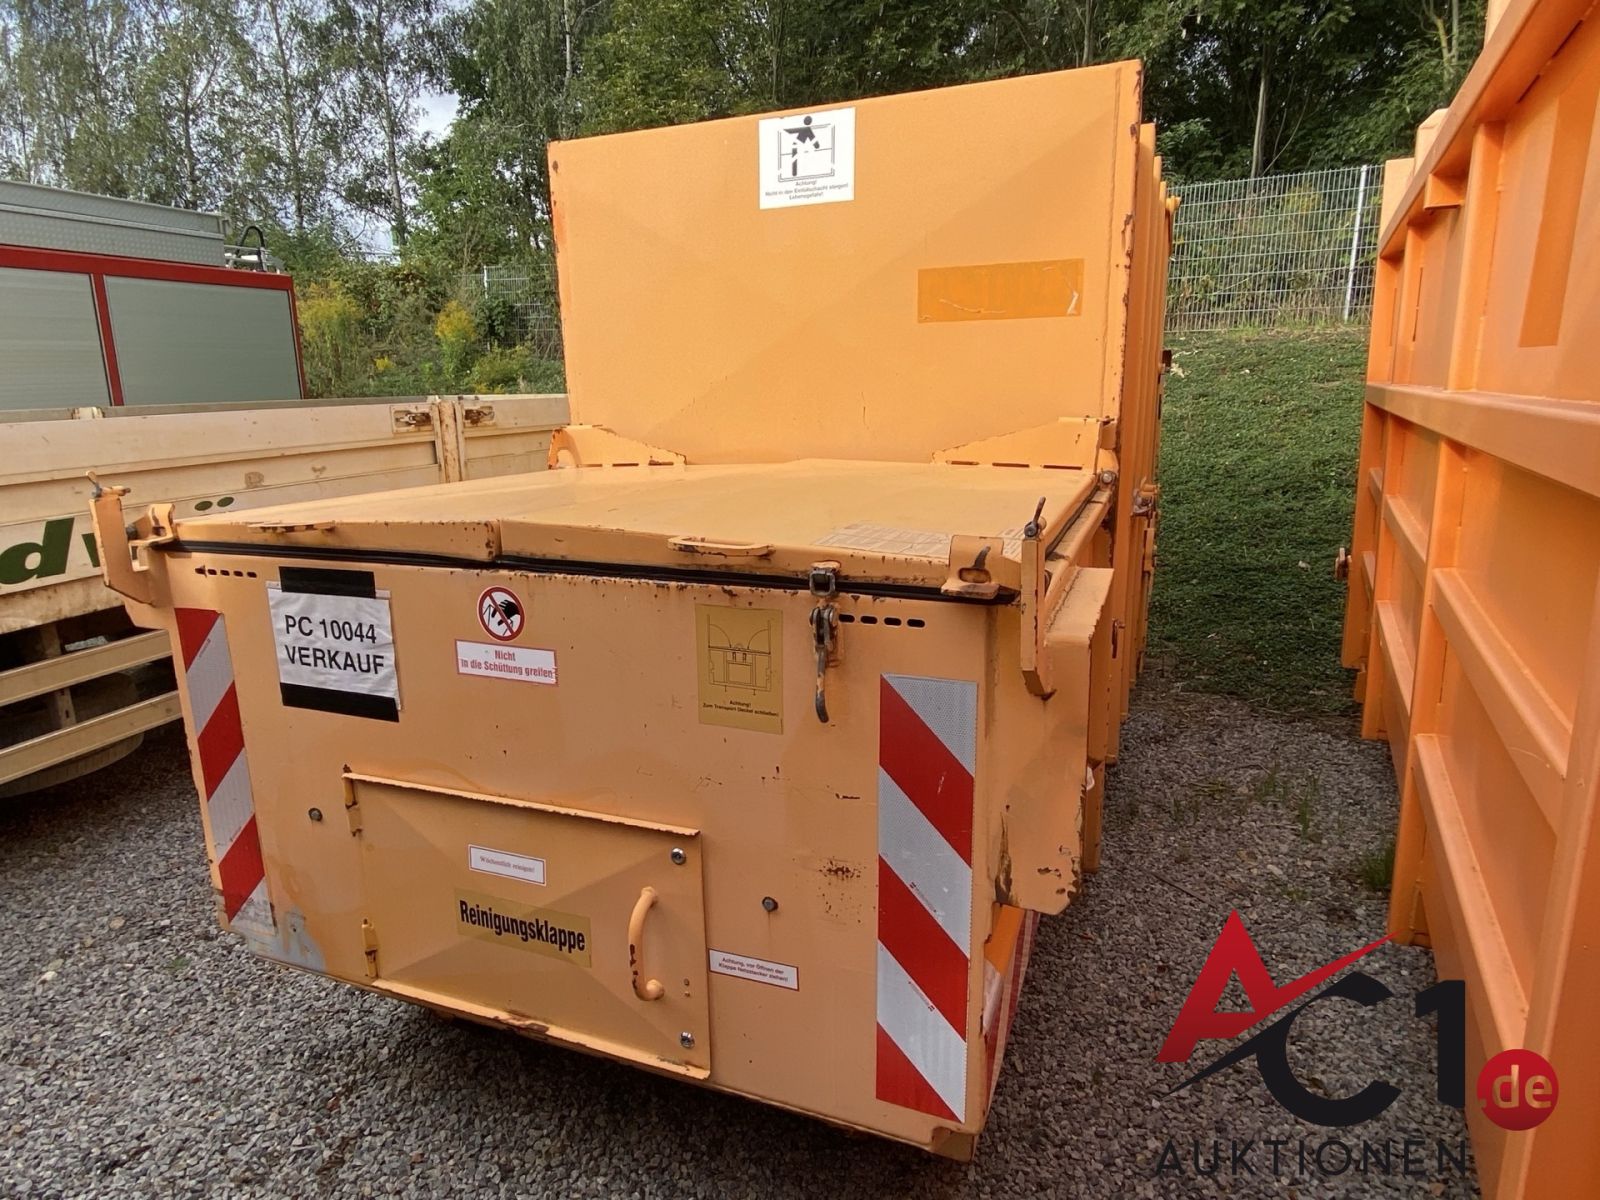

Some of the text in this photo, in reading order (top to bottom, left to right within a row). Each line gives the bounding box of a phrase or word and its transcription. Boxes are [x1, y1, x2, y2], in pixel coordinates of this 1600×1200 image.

[284, 614, 377, 644] PC 10044
[284, 644, 385, 675] VERKAUF
[470, 661, 482, 670] die
[484, 660, 523, 676] Schüttung
[525, 666, 553, 678] greifen
[494, 649, 516, 662] Nicht
[459, 899, 586, 954] Reinigungsklappe
